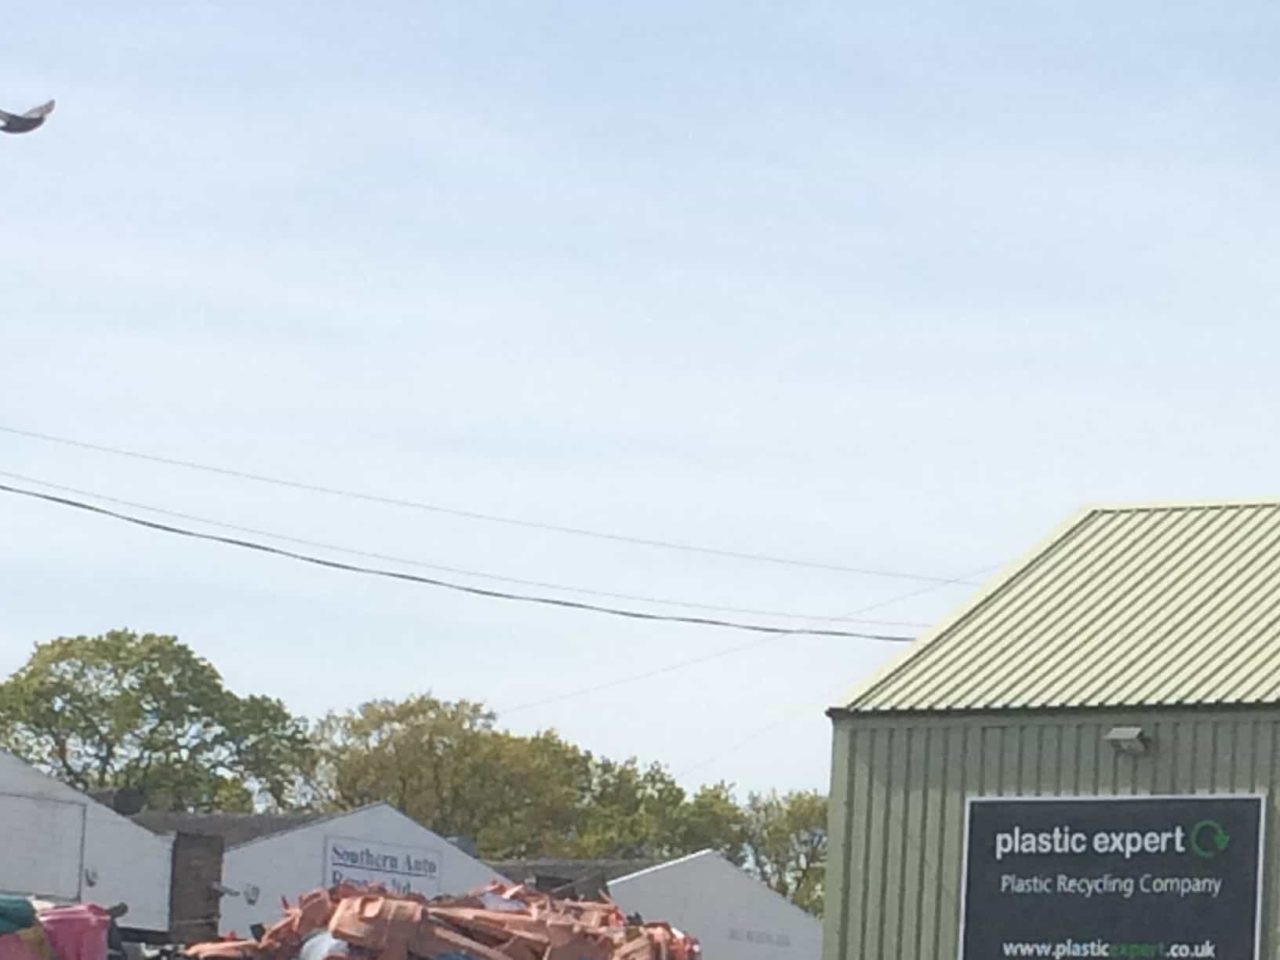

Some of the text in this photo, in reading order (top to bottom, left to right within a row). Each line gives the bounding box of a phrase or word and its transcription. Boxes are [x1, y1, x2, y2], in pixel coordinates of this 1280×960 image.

[995, 825, 1185, 860] plastic expert
[332, 846, 437, 874] Southern Auto
[1000, 874, 1222, 898] Plastic Recycling Company
[1002, 938, 1216, 960] www.plasticexpert.co.uk
